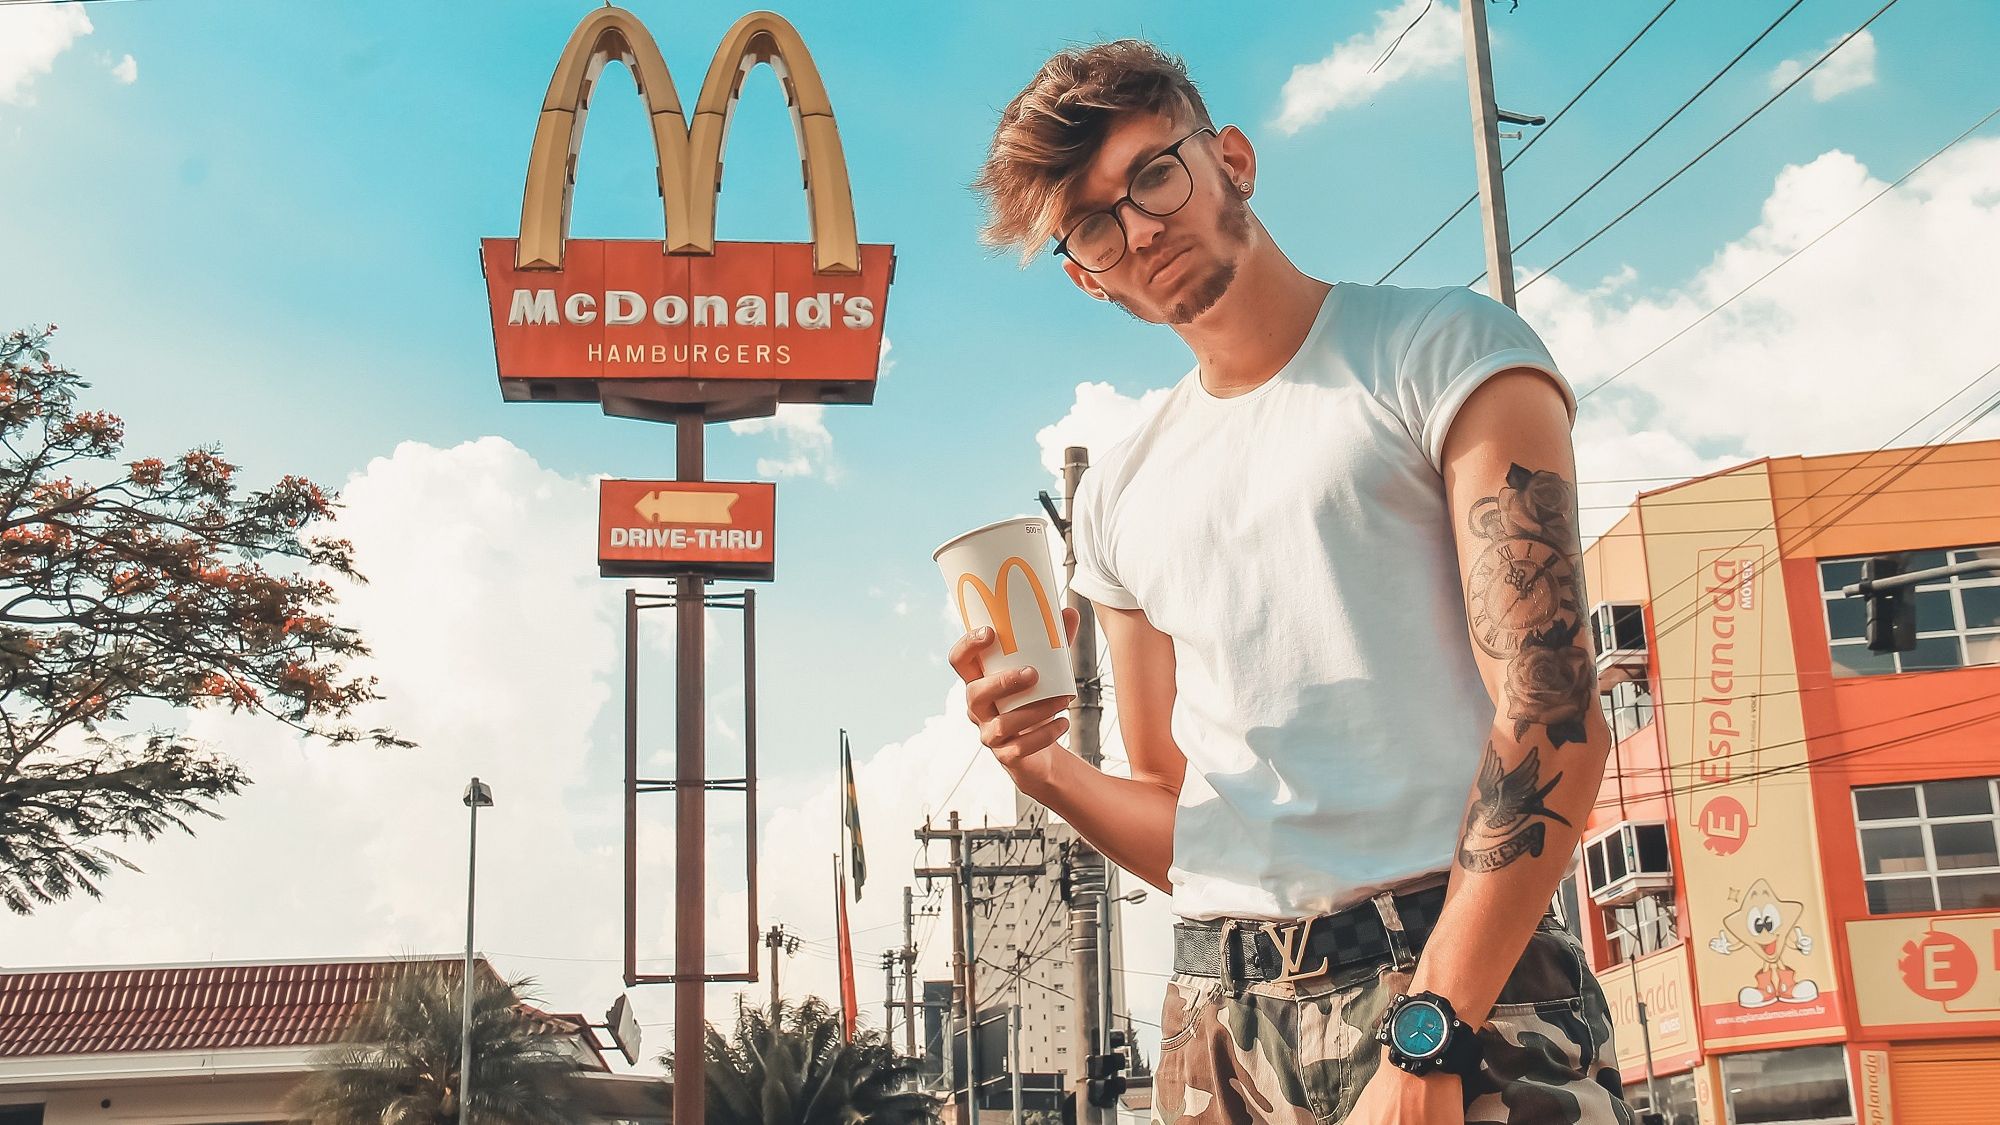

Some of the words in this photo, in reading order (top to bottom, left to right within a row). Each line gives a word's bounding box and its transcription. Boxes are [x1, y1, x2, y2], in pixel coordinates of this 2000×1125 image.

[507, 288, 875, 330] McDonald's
[587, 343, 792, 364] HAMBURGERS
[610, 527, 763, 550] DRIVE-THRU
[1025, 526, 1037, 534] 500
[1700, 560, 1740, 784] Esplanada
[1923, 944, 1958, 990] E
